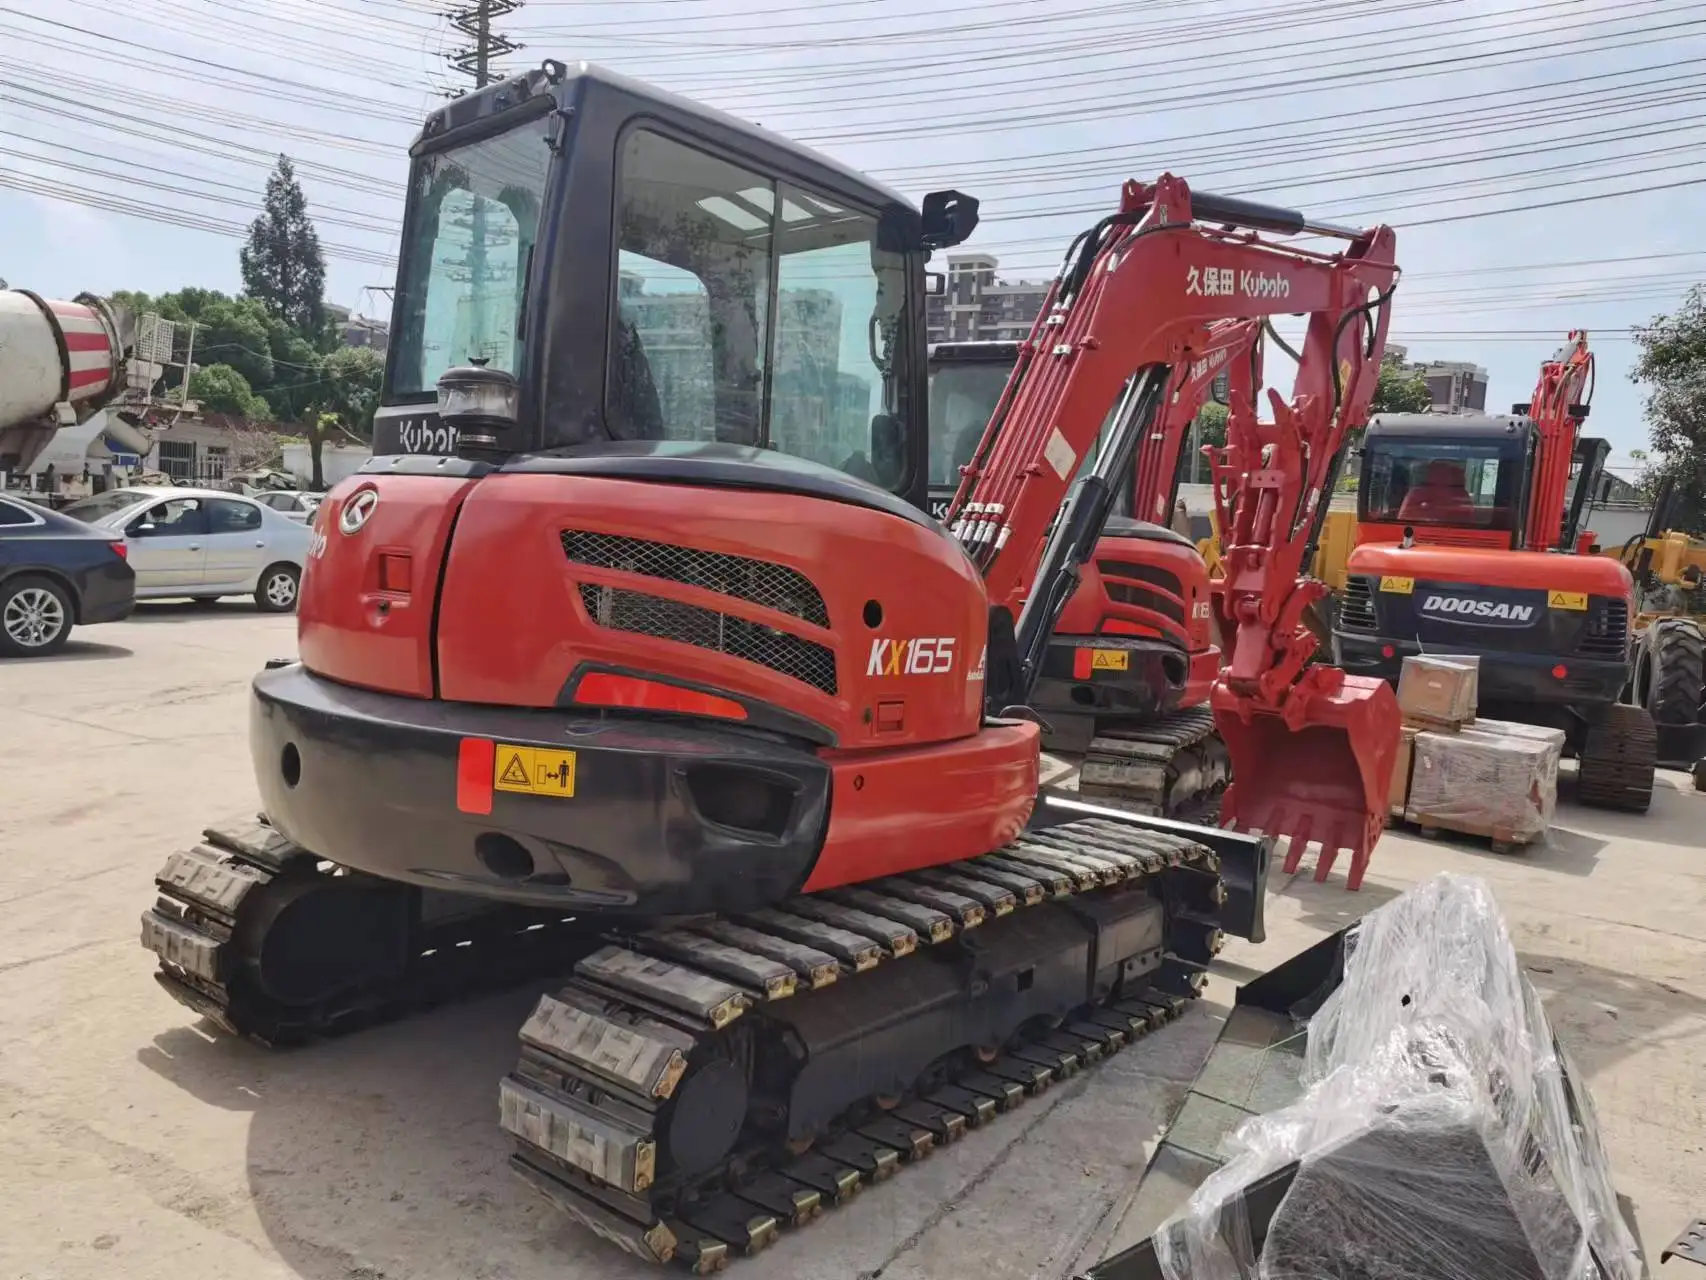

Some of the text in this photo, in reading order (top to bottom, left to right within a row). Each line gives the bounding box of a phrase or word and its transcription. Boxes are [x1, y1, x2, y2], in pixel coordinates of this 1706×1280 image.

[1186, 265, 1289, 297] 久保田 Kubota
[400, 420, 460, 452] Kubot
[1423, 595, 1532, 620] DOOSAN
[866, 637, 955, 675] KX165
